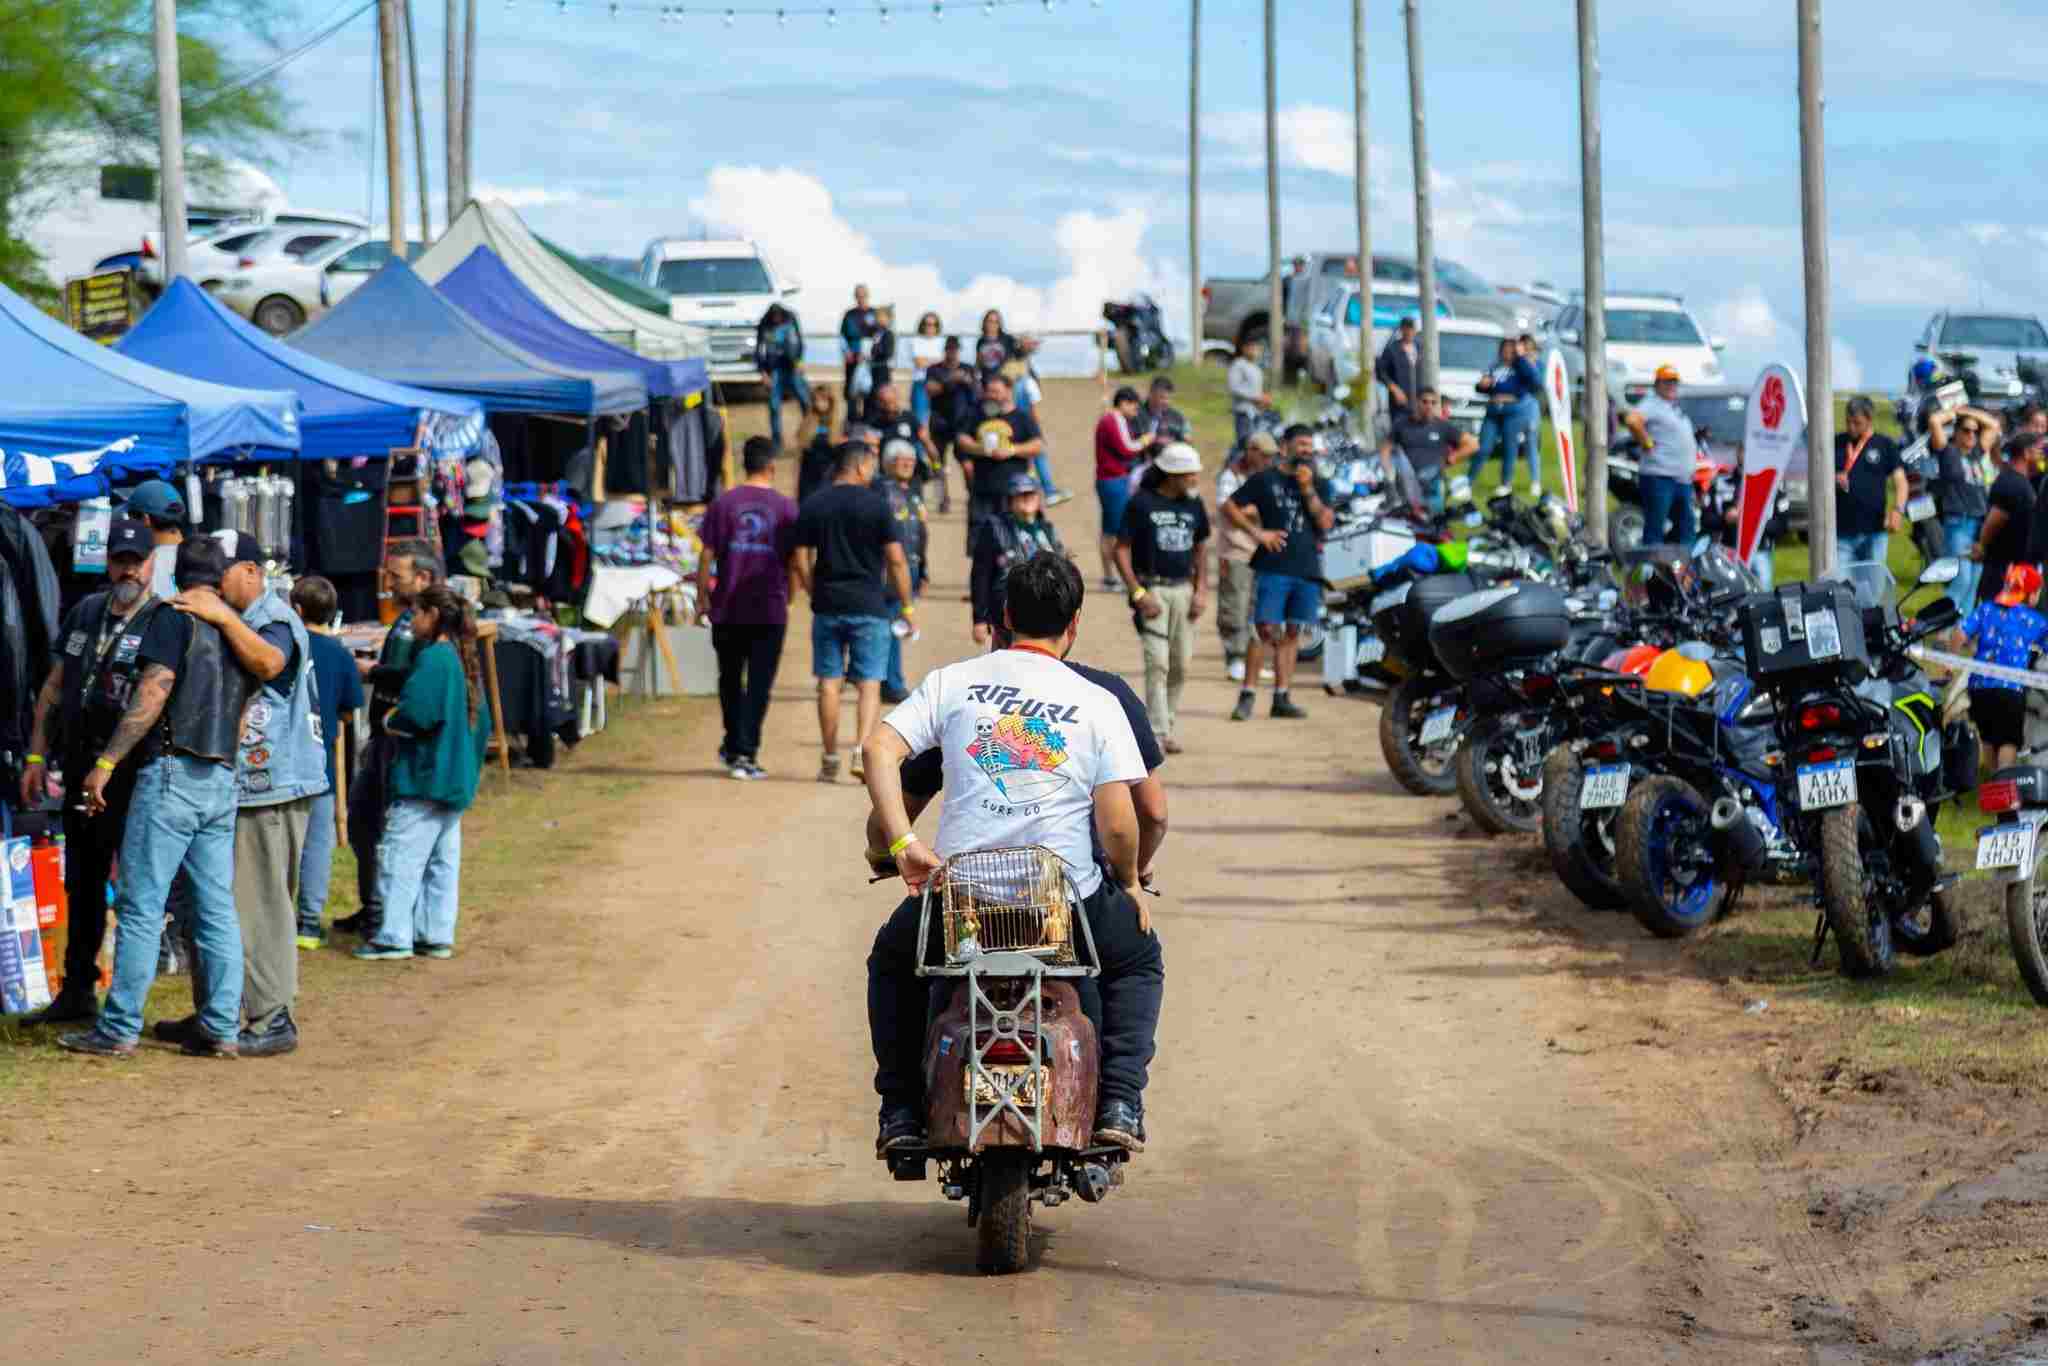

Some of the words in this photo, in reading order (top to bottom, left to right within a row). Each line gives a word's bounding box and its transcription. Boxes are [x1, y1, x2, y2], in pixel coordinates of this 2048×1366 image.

[968, 684, 1020, 704] RIP
[1000, 698, 1079, 724] CURL
[1811, 771, 1841, 787] A12
[981, 799, 1015, 817] SURF
[1023, 804, 1041, 817] CO
